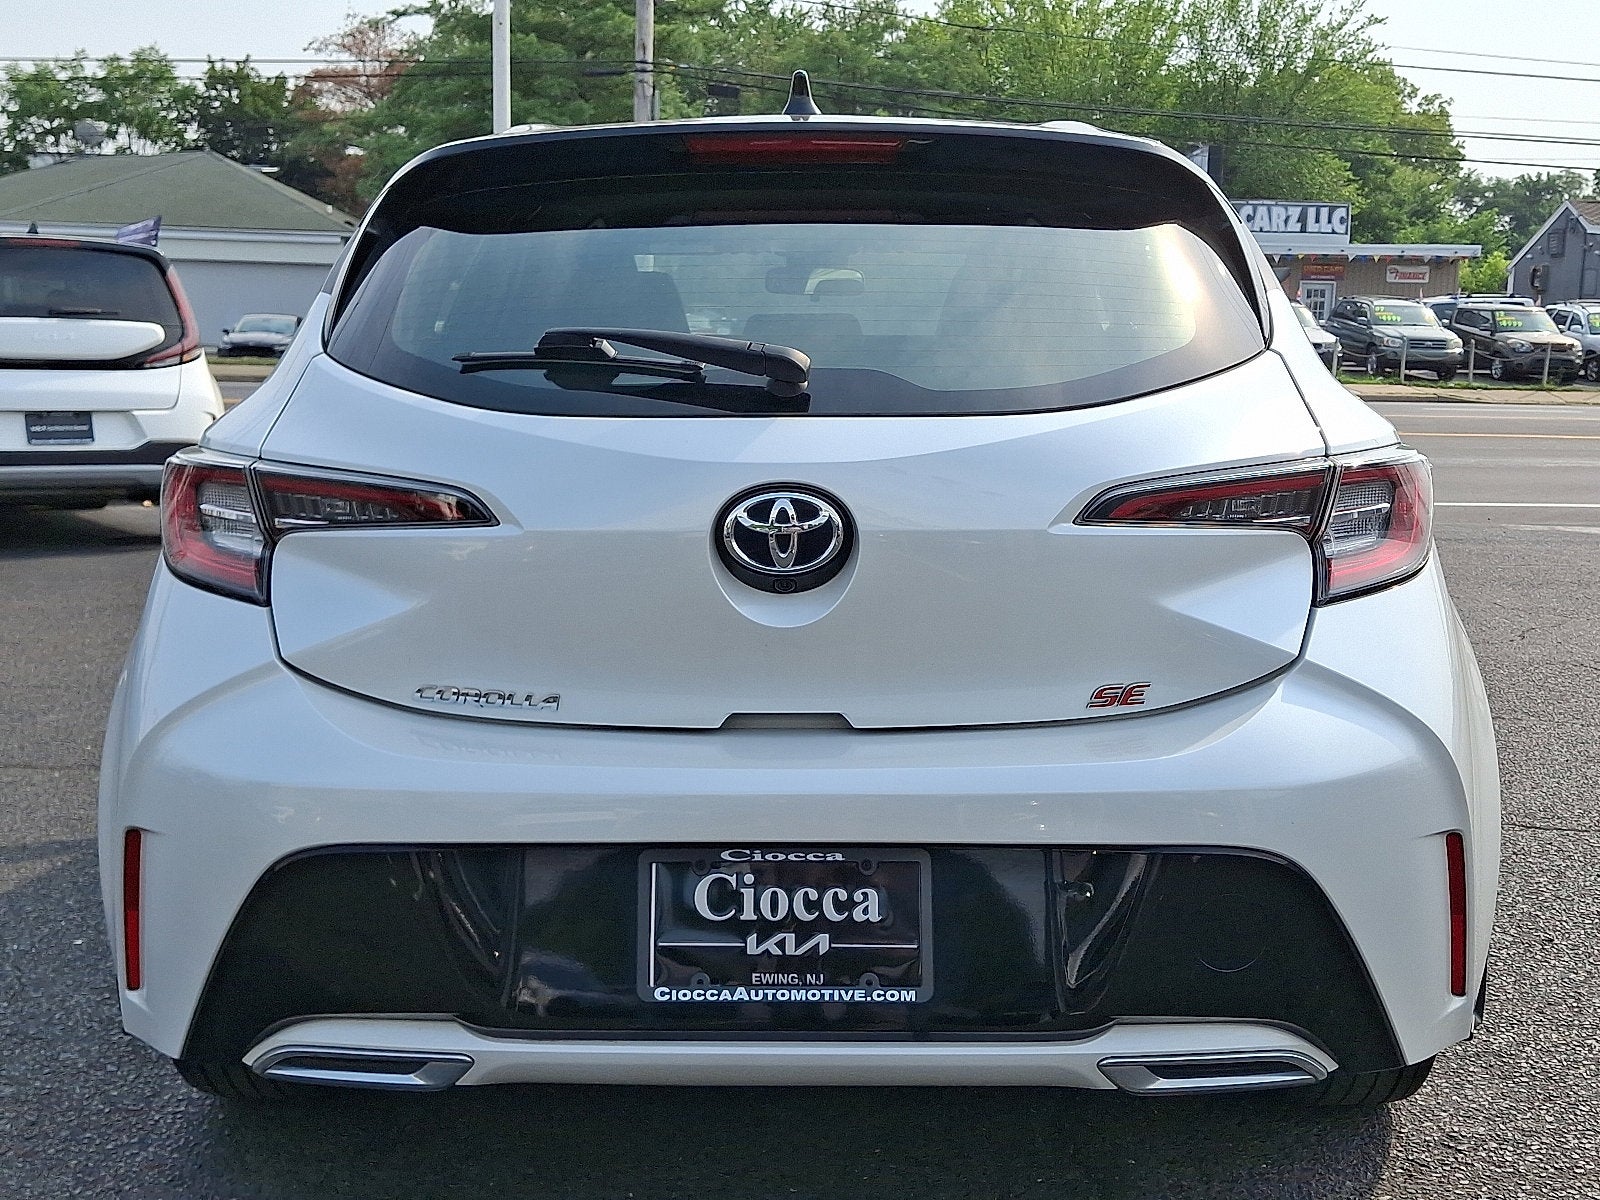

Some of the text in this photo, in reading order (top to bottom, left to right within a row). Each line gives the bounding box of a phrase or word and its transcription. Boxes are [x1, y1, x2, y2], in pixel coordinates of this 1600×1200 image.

[1240, 204, 1347, 234] CARZ LLC
[414, 684, 561, 711] COROLLA
[1086, 681, 1152, 709] SE
[720, 849, 845, 861] Ciocca
[694, 872, 883, 923] Ciocca
[746, 932, 830, 955] KIA
[752, 973, 824, 986] EWING, NJ
